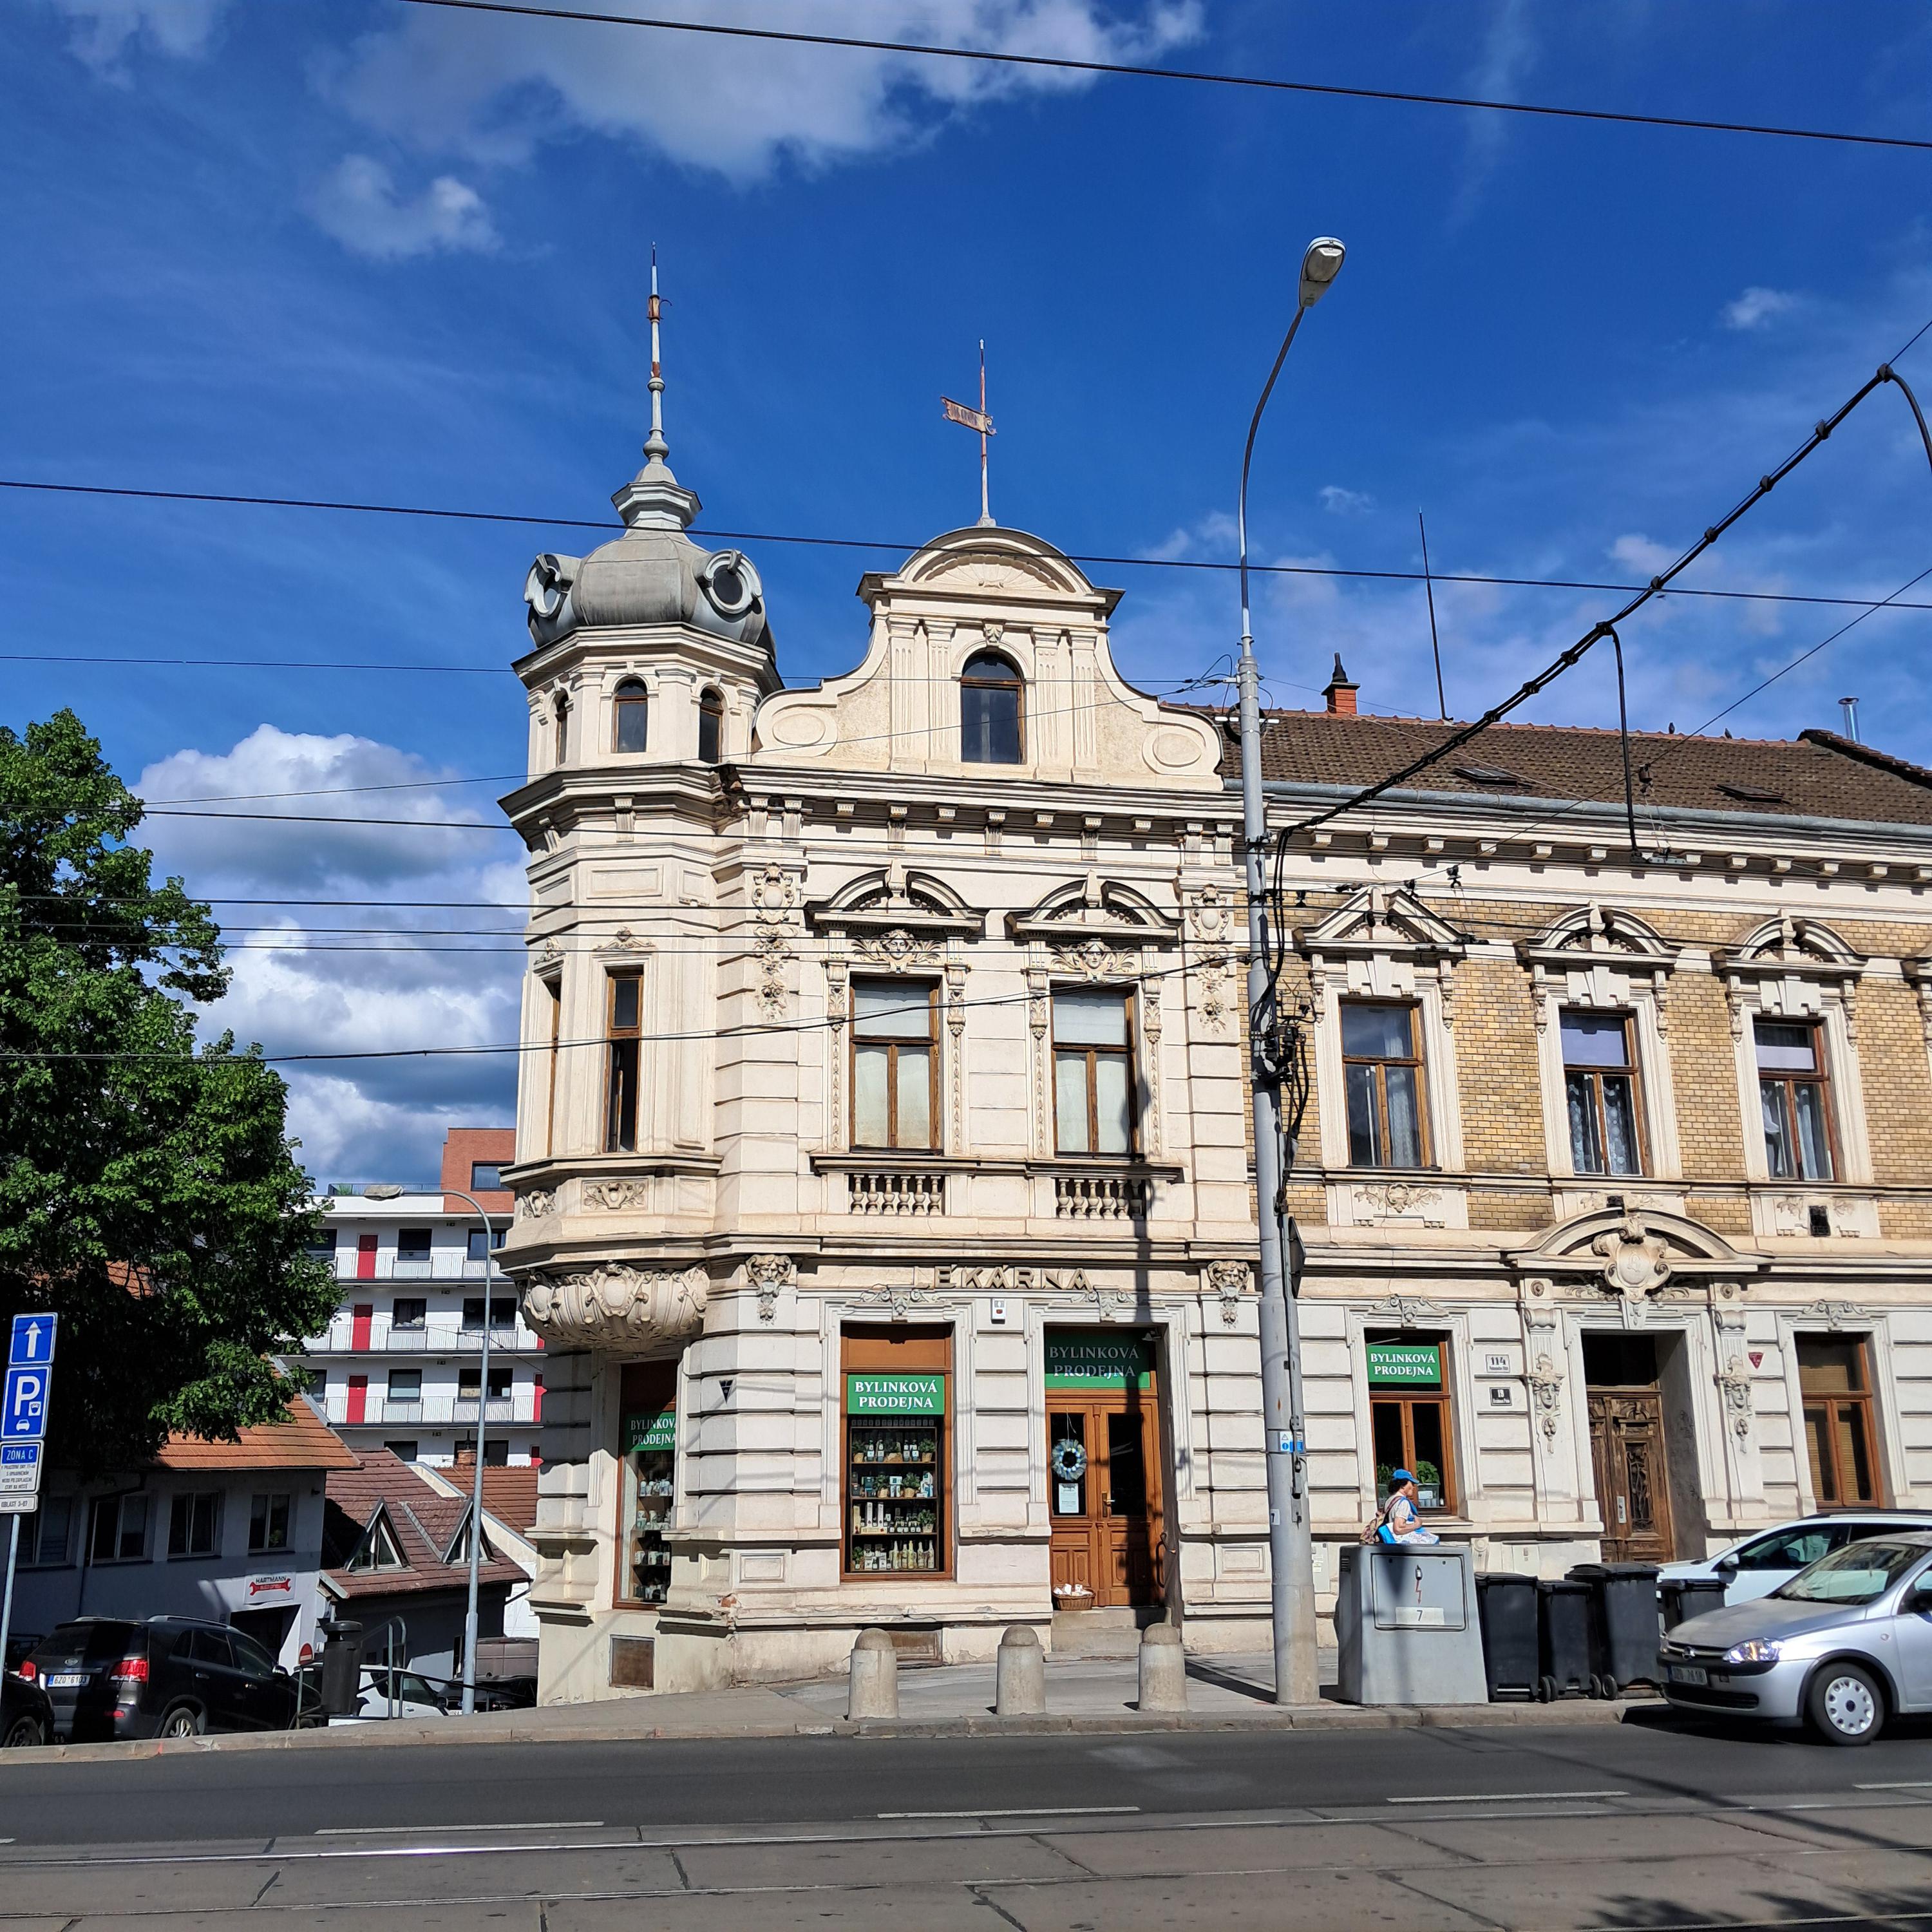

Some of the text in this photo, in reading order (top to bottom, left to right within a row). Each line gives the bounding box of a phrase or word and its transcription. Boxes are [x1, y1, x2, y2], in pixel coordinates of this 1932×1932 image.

[1049, 1345, 1139, 1359] BYLINKOVÁ
[1370, 1352, 1435, 1363] BYLINKOVÁ
[1491, 1356, 1506, 1365] 114
[1054, 1365, 1135, 1379] PRODEJNA
[1374, 1366, 1434, 1377] PRODEJNA
[855, 1379, 938, 1393] BYLINKOVÁ
[14, 1376, 41, 1416] P
[858, 1396, 934, 1410] PRODEJNA
[630, 1417, 676, 1430] BYLINKOV
[632, 1433, 676, 1446] PRODEJNA
[6, 1448, 33, 1461] ZÓNA C
[1417, 1610, 1423, 1621] 7
